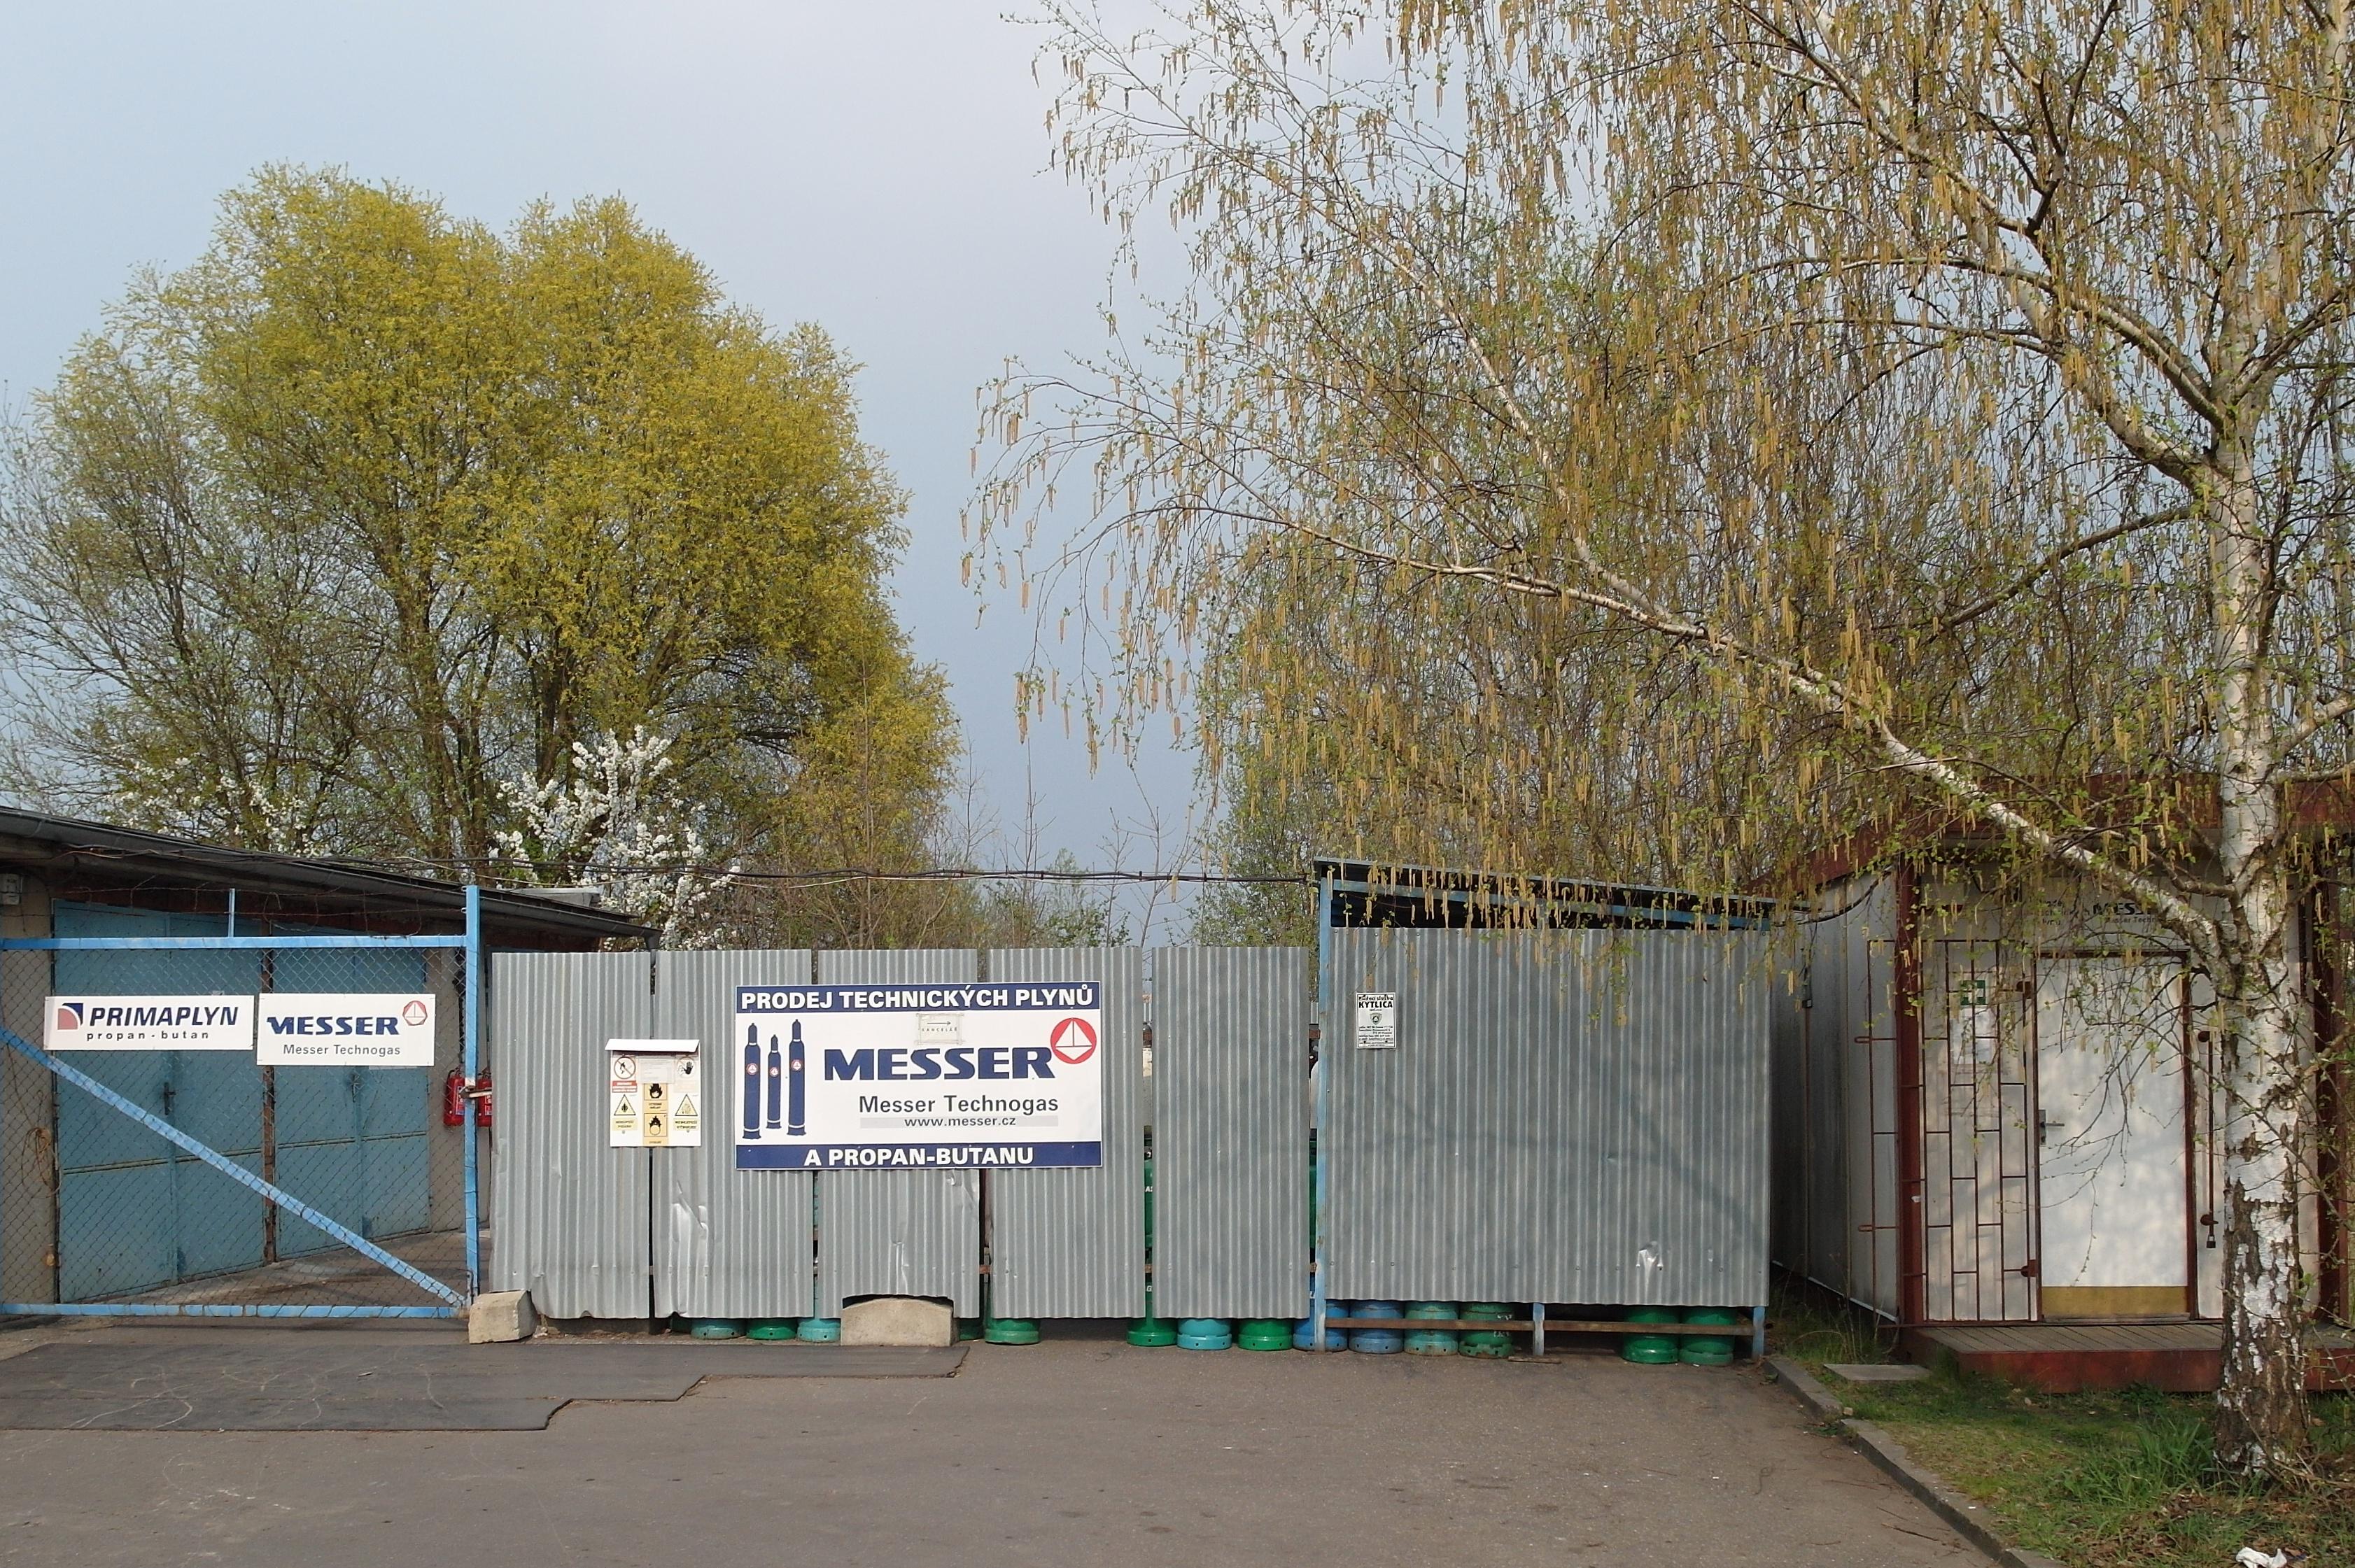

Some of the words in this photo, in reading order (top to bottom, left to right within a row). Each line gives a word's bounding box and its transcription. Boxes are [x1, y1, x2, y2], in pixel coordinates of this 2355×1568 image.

[741, 991, 833, 1010] PRODEJ
[839, 985, 1008, 1009] TECHNICKÝCH
[1015, 984, 1092, 1006] PLYNŮ
[90, 1006, 239, 1026] PRIMAPLYN
[267, 1016, 400, 1035] MESSER
[283, 1045, 329, 1054] Messer
[333, 1045, 400, 1057] Technogas
[824, 1047, 1055, 1080] MESSER
[859, 1096, 936, 1113] Messer
[943, 1095, 1059, 1115] Technogas
[904, 1117, 1016, 1127] www.messer.cz
[804, 1147, 822, 1166] A
[826, 1147, 1034, 1166] PROPAN-BUTANU
